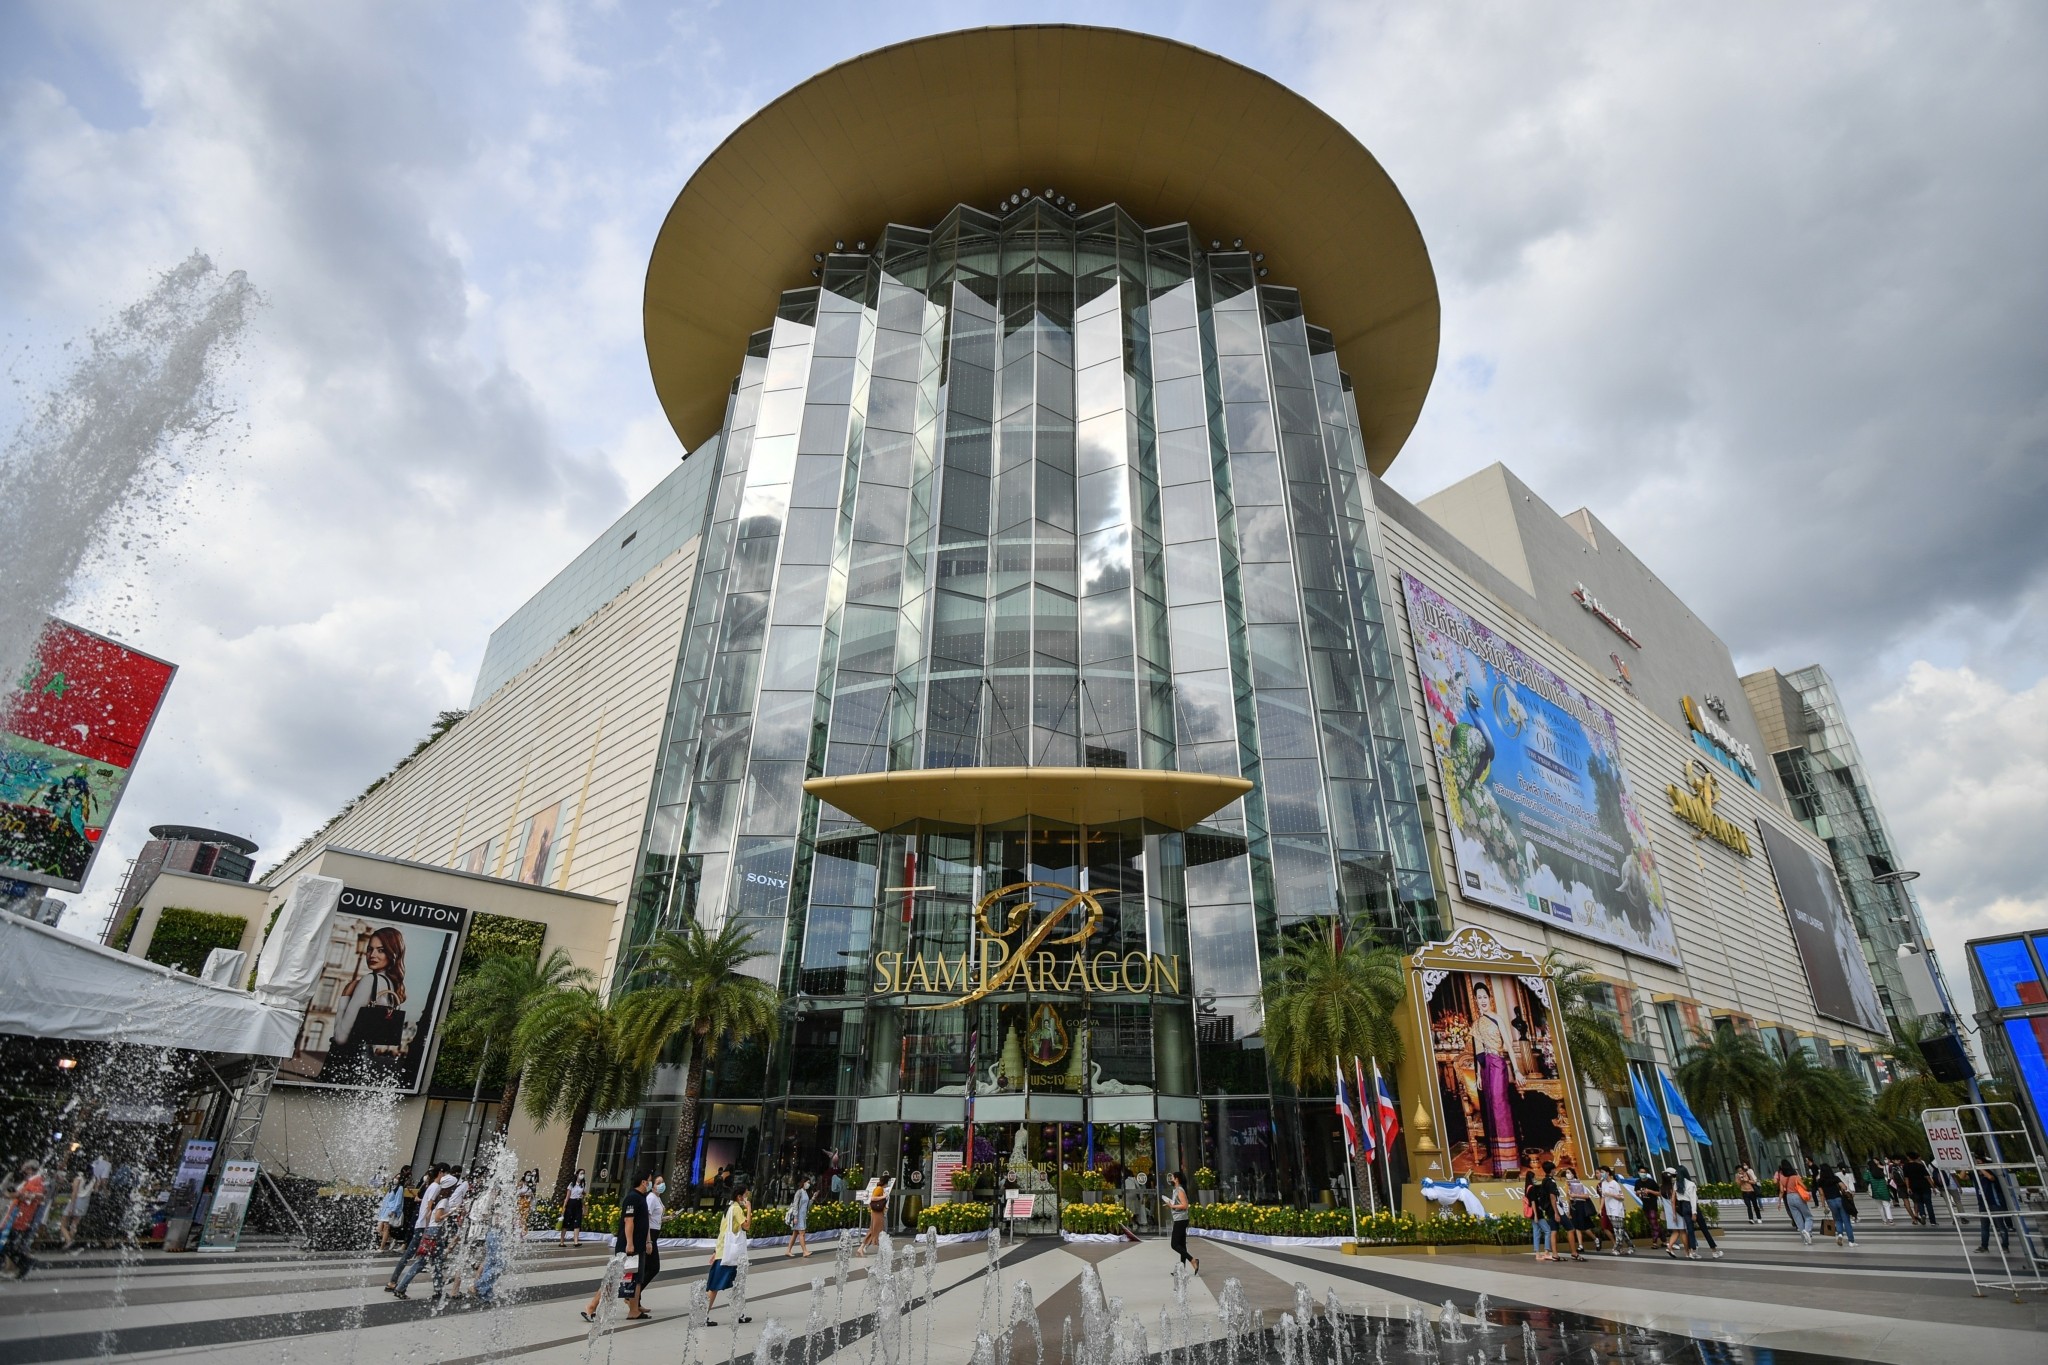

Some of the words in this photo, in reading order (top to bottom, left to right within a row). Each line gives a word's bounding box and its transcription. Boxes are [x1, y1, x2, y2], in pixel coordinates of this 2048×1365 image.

[1536, 731, 1582, 770] ORCHID
[746, 872, 787, 888] SONY
[340, 892, 383, 910] OUIS
[390, 900, 460, 923] VUITTON
[873, 950, 968, 993] SIAM
[1929, 1127, 1959, 1141] EAGLE
[1937, 1147, 1963, 1160] EYES
